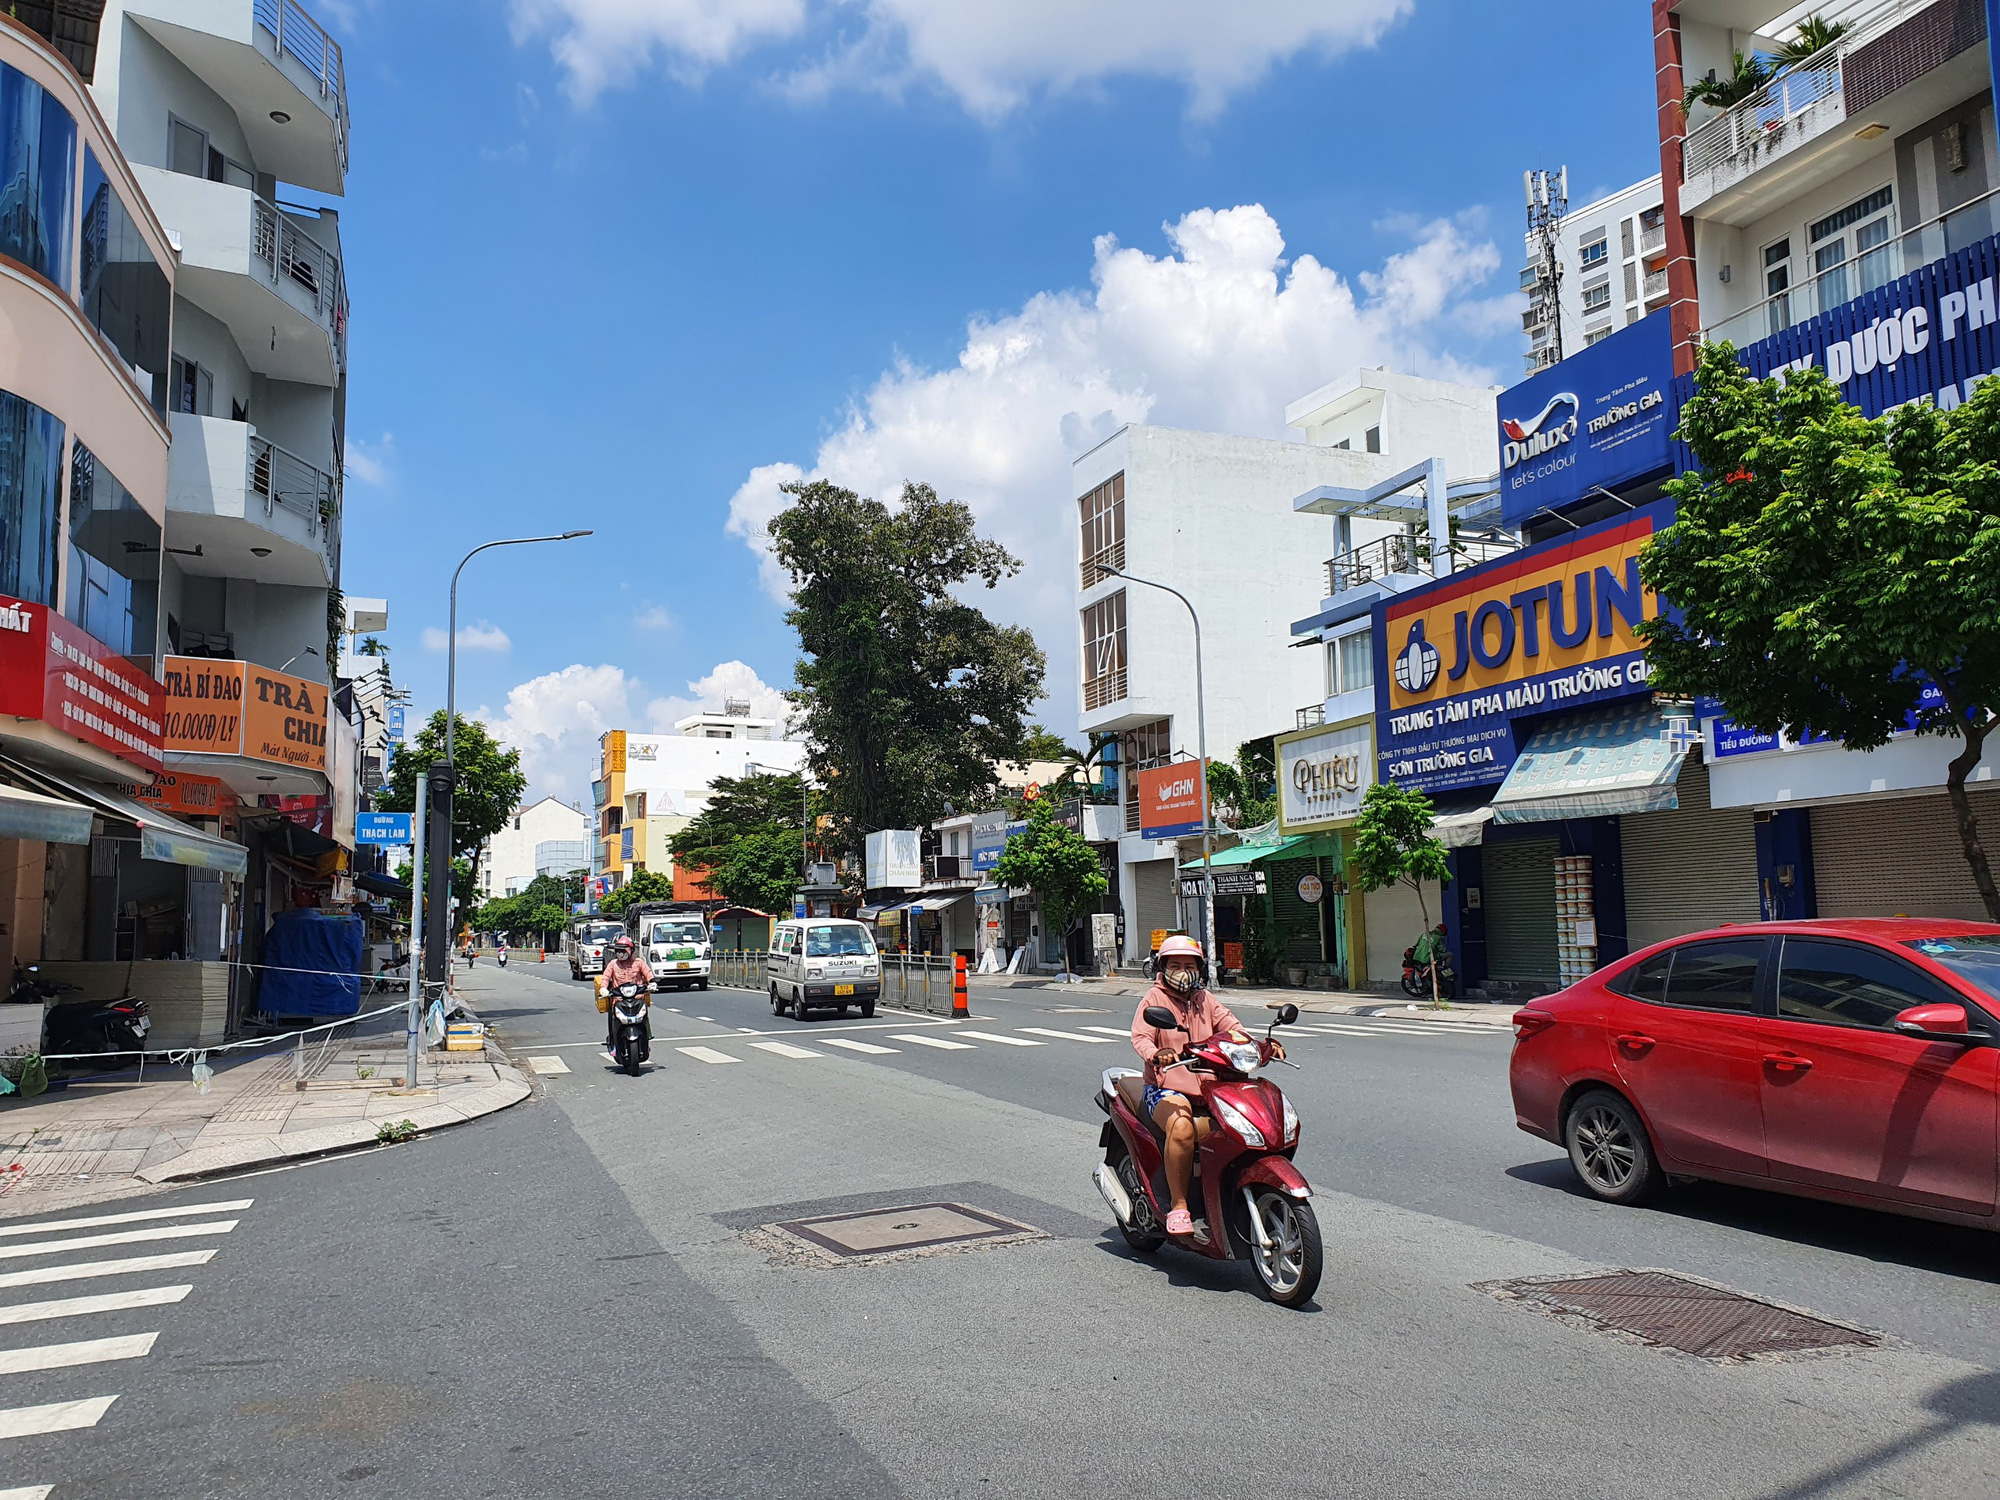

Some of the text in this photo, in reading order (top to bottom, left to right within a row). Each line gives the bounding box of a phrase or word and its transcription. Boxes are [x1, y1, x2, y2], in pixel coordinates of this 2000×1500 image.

[1826, 305, 1930, 385] DƯỢC
[1939, 276, 2000, 342] PH
[1611, 387, 1624, 397] Tâm
[1624, 382, 1636, 391] Pha
[1586, 401, 1638, 434] TRƯỜNG
[1639, 389, 1663, 411] GIA
[1503, 423, 1570, 470] Dulux
[1511, 452, 1577, 490] let's colour
[1447, 555, 1644, 681] JOTUN
[165, 666, 192, 698] TRÀ
[196, 667, 210, 699] BÍ
[213, 674, 242, 701] ĐAO
[1922, 686, 1944, 699] GA
[255, 676, 315, 714] TRÀ
[1389, 709, 1434, 735] TRUNG
[1435, 700, 1469, 725] TÂM
[1471, 693, 1504, 718] PHA
[1506, 681, 1546, 711] MÀU
[1547, 664, 1623, 702] TRƯỜNG
[1378, 749, 1393, 761] CÔNG
[1394, 748, 1401, 757] TY
[1402, 745, 1418, 756] TNHH
[1480, 730, 1496, 742] DỊCH
[1497, 727, 1507, 739] VỤ
[1720, 733, 1773, 750] TIỂU ĐƯỜNG
[261, 742, 281, 757] Mát
[282, 746, 310, 764] Người
[1388, 759, 1414, 779] SƠN
[1415, 750, 1467, 774] TRƯỜNG
[1468, 745, 1494, 765] GIA
[1172, 778, 1195, 798] GHN
[1307, 791, 1342, 804] STUDIO
[374, 815, 394, 824] ĐƯỜNG
[362, 828, 406, 841] THẠCH LAM
[1216, 874, 1254, 883] THANH NGA
[1255, 871, 1266, 881] HOA
[1300, 882, 1310, 890] HOA
[1181, 880, 1198, 896] HOA
[1198, 879, 1216, 896] TI
[1256, 882, 1268, 895] TƯƠI
